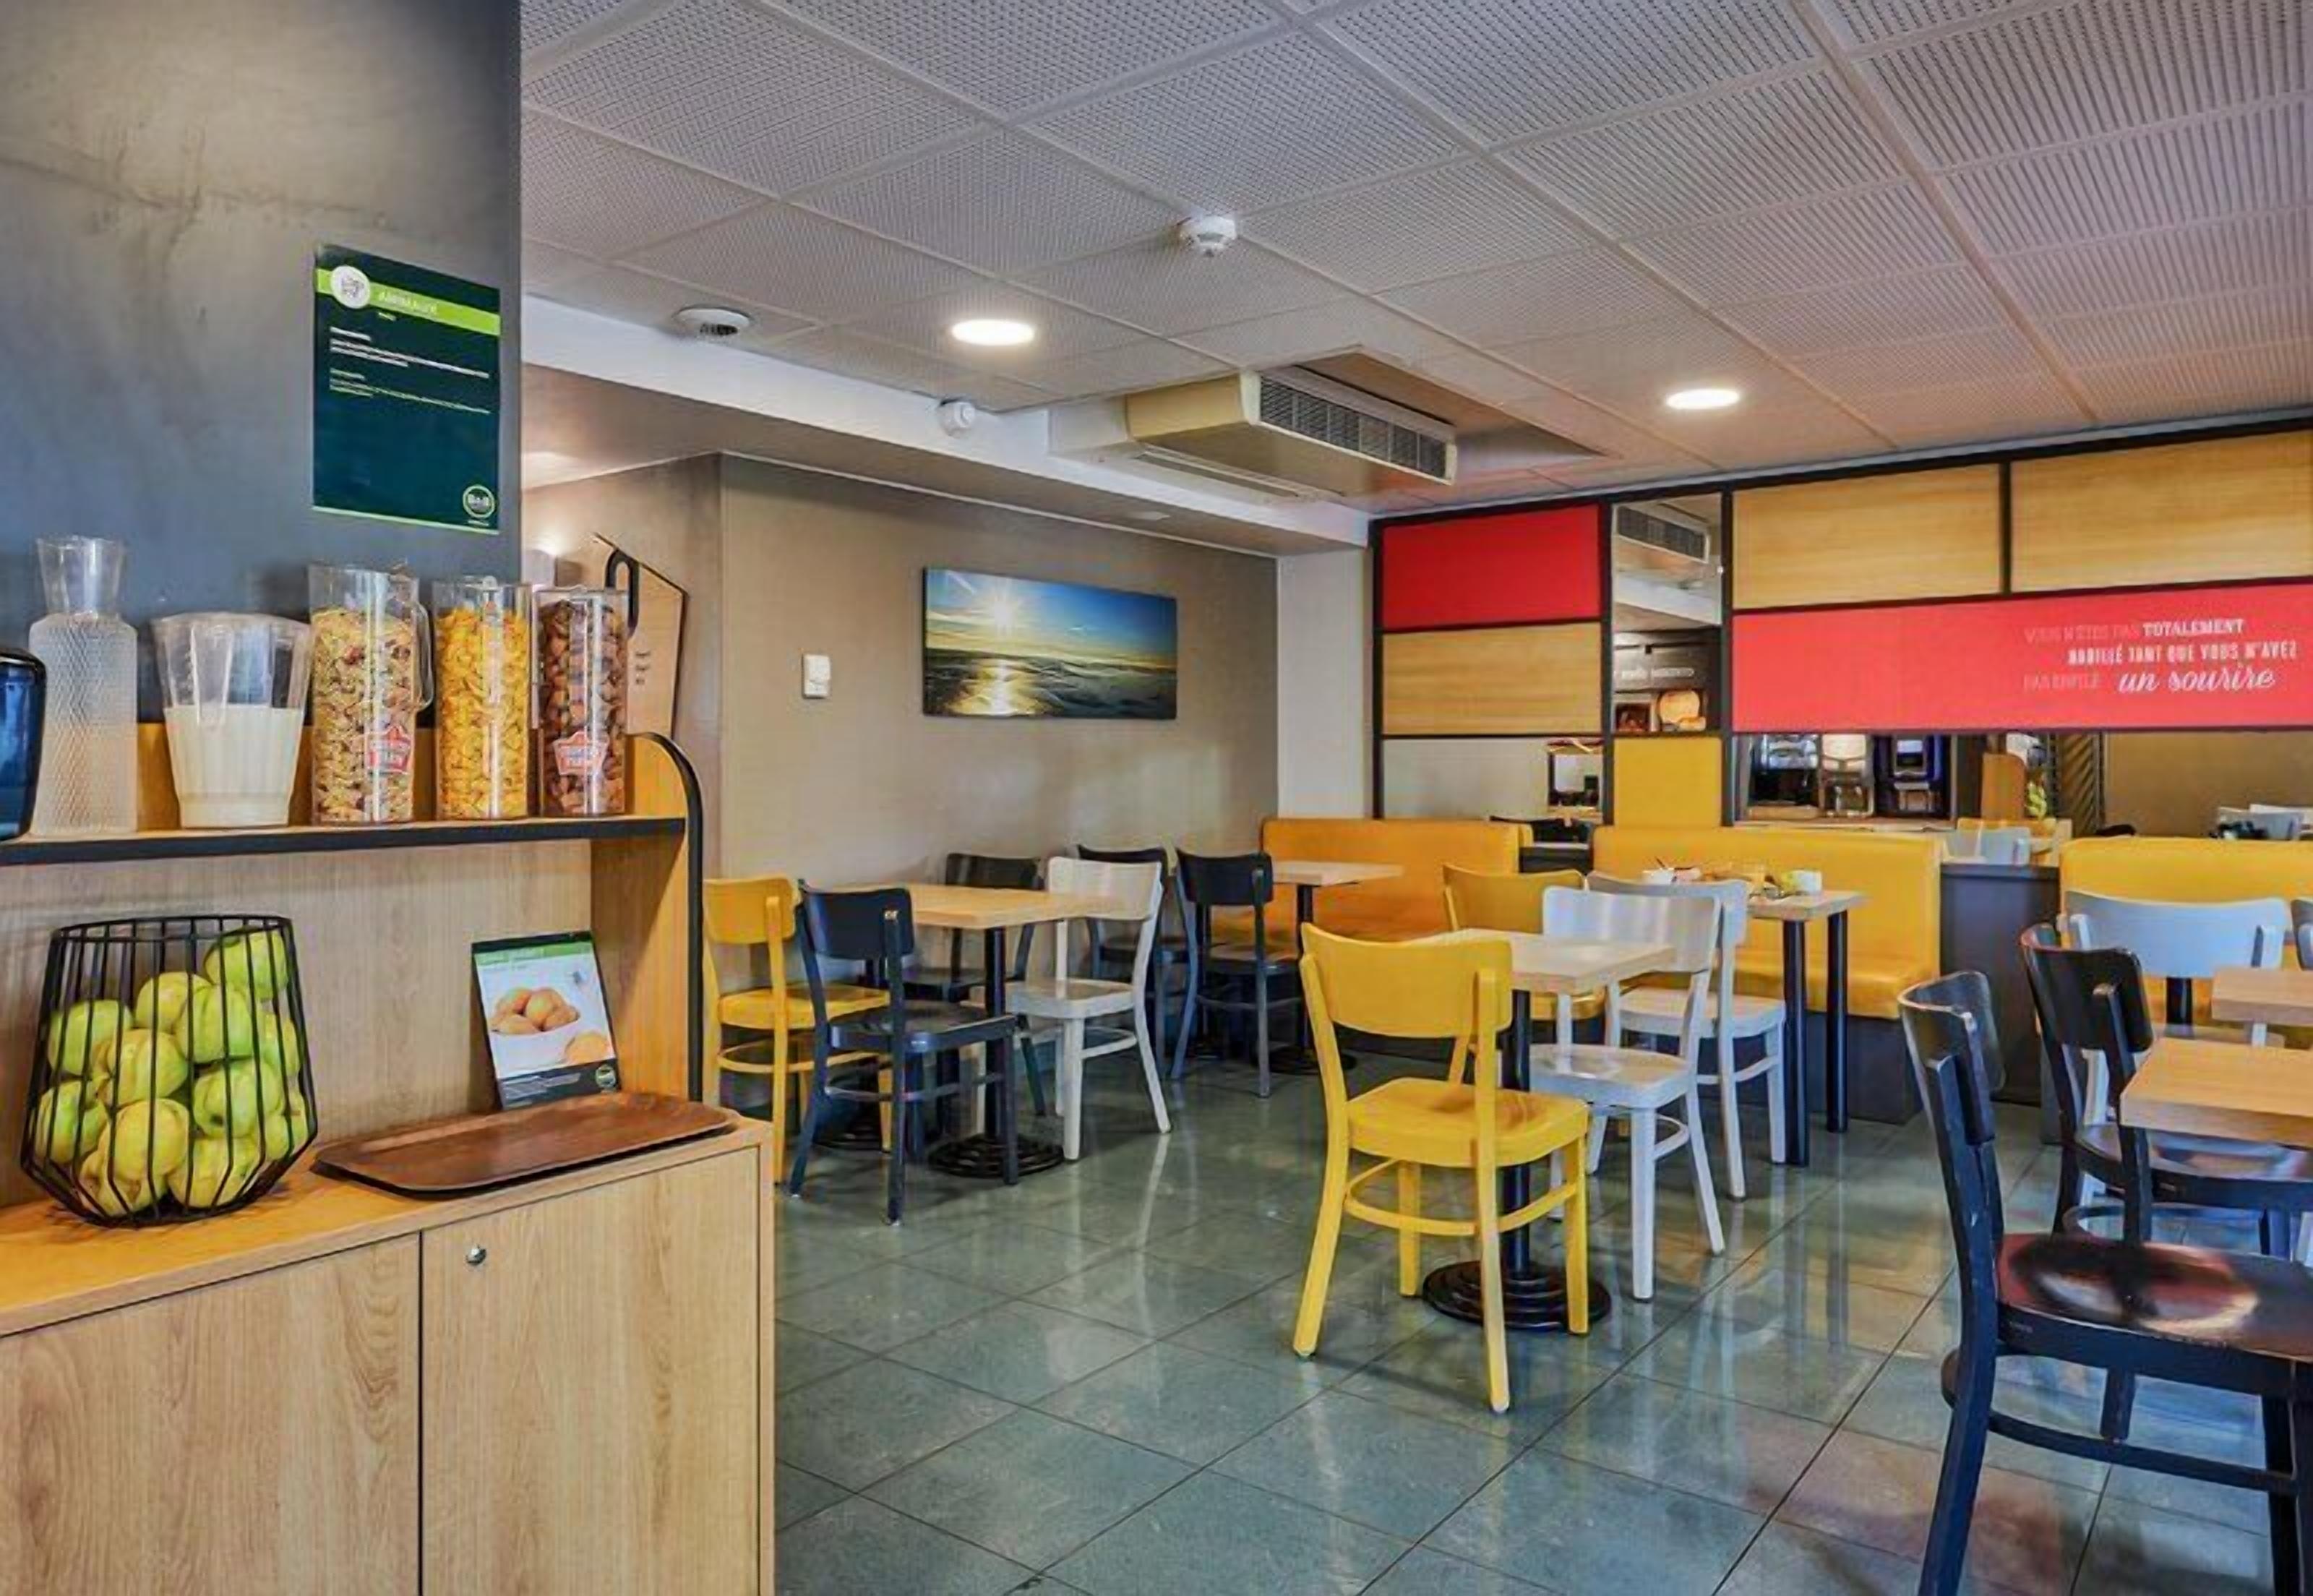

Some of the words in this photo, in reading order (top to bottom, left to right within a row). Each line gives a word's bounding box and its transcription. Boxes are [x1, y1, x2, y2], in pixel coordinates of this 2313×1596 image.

[2143, 618, 2244, 636] TOTALEMENT
[2200, 642, 2239, 660] VOUS
[2119, 672, 2160, 692] un
[2168, 662, 2275, 691] sourire
